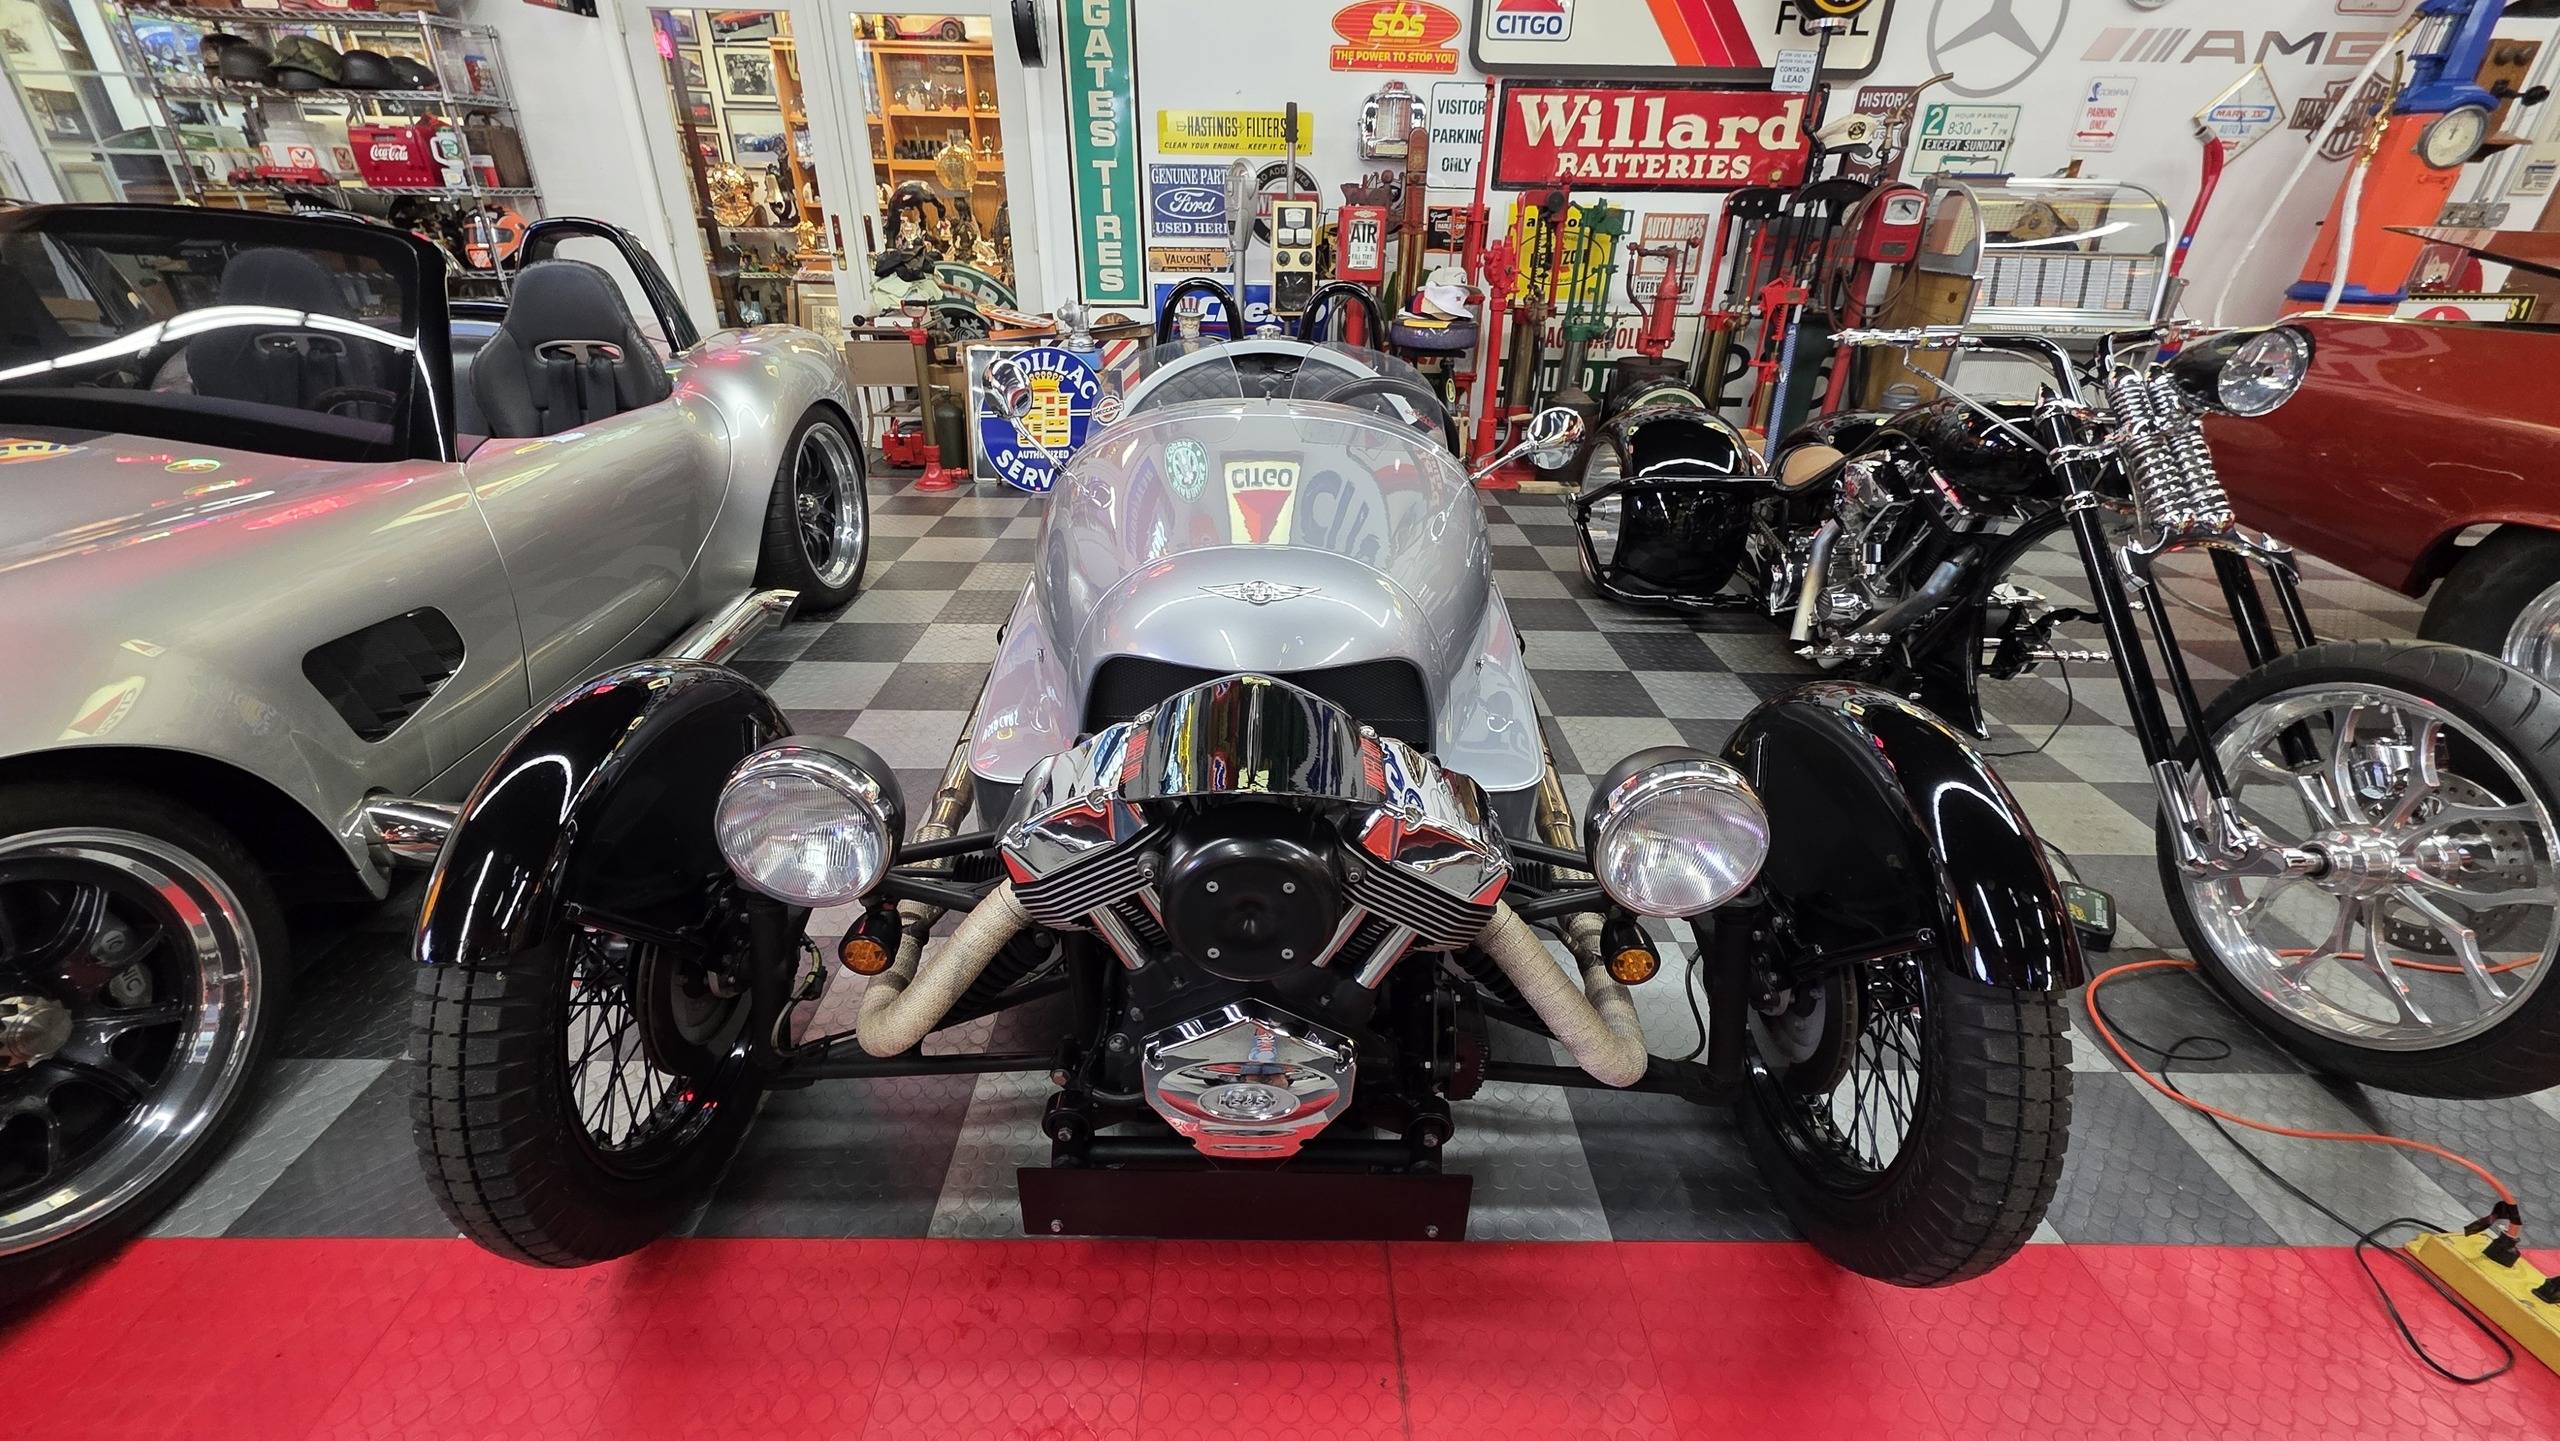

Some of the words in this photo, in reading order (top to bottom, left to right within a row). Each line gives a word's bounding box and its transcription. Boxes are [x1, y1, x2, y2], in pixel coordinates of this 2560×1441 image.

[1496, 15, 1563, 35] CITGO
[1775, 0, 1869, 36] FL
[1335, 50, 1353, 60] THE
[1356, 51, 1390, 62] POWER
[1393, 52, 1406, 62] TO
[1407, 52, 1432, 63] STOP
[1434, 53, 1456, 64] YOU
[2180, 30, 2389, 65] AMG
[1082, 0, 1117, 147] GATES
[1782, 75, 1804, 83] LEAD
[1858, 92, 1914, 108] HISTOR
[1517, 94, 1804, 151] Willard
[1925, 106, 1944, 134] 2
[2087, 107, 2118, 118] PARKING
[2216, 110, 2248, 118] MARK
[1187, 116, 1238, 137] HASTINGS
[1246, 117, 1287, 138] FILTERS
[1947, 121, 1972, 135] 8:30
[1990, 121, 1999, 135] 7
[2089, 120, 2108, 130] ONLY
[1279, 143, 1307, 151] CLN!
[1925, 139, 1961, 151] EXCEPT
[1963, 140, 2002, 151] SUNDAY
[1151, 168, 1198, 185] GENUINE
[1556, 152, 1752, 181] BATTERIES
[1169, 190, 1216, 214] Ford
[1092, 160, 1125, 292] TIRES
[1155, 222, 1192, 234] USED
[1350, 223, 1378, 243] AIR
[1645, 217, 1672, 239] AUTO
[1672, 217, 1706, 240] RACES
[1164, 253, 1211, 266] VALVOLINE
[1017, 351, 1099, 400] DILLAC
[996, 450, 1055, 488] SERV
